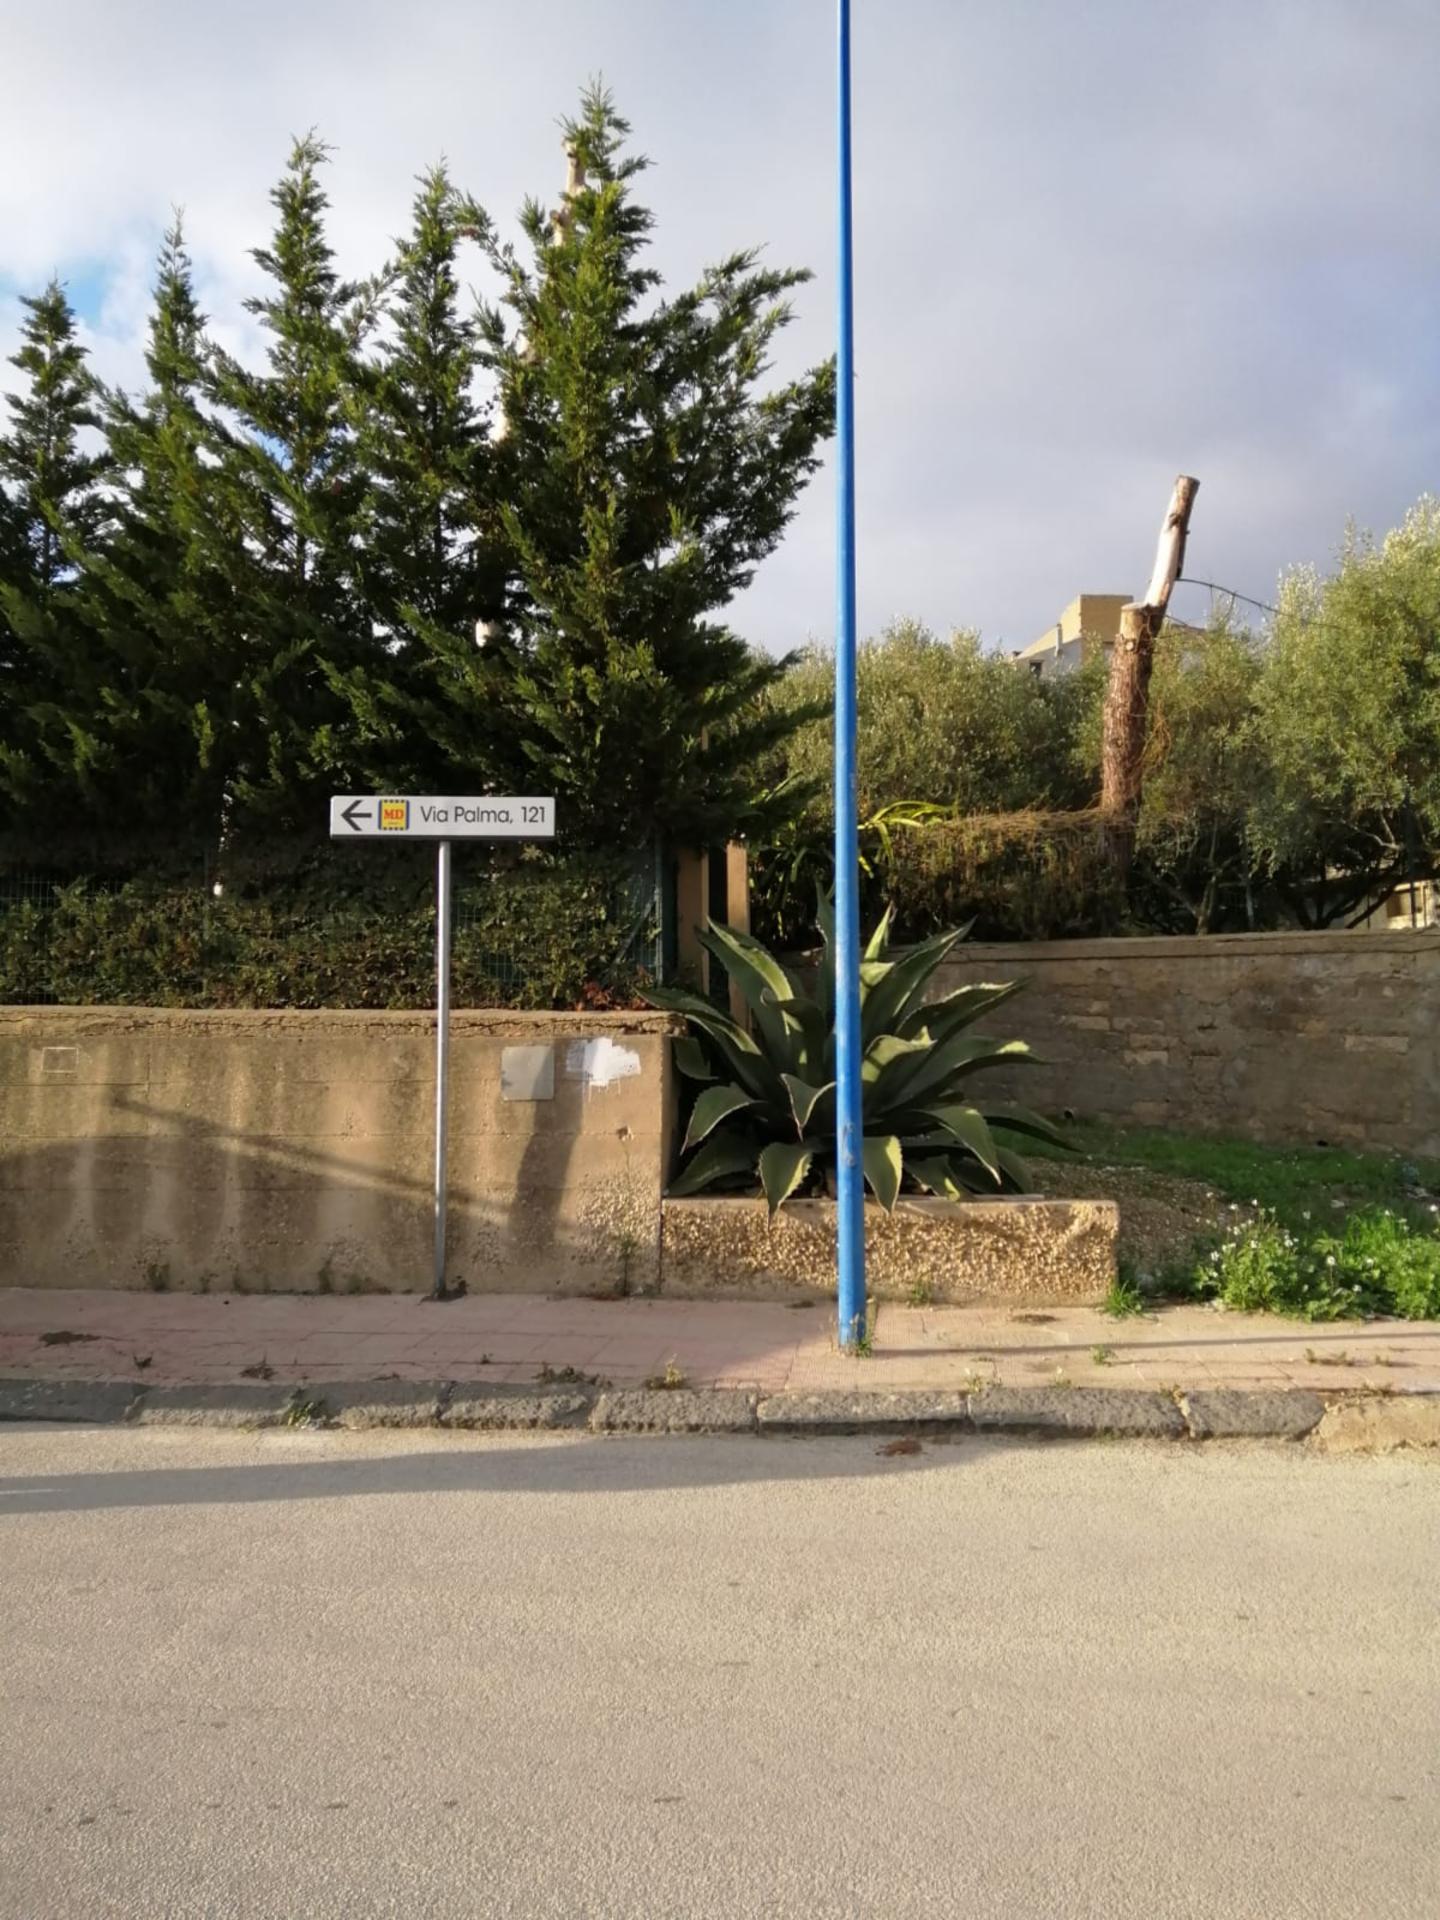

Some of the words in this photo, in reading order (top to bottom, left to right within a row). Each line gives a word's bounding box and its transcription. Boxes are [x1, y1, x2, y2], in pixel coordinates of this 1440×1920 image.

[384, 808, 404, 820] MD
[420, 805, 449, 823] Via
[454, 805, 514, 825] Palma,
[521, 805, 545, 823] 121
